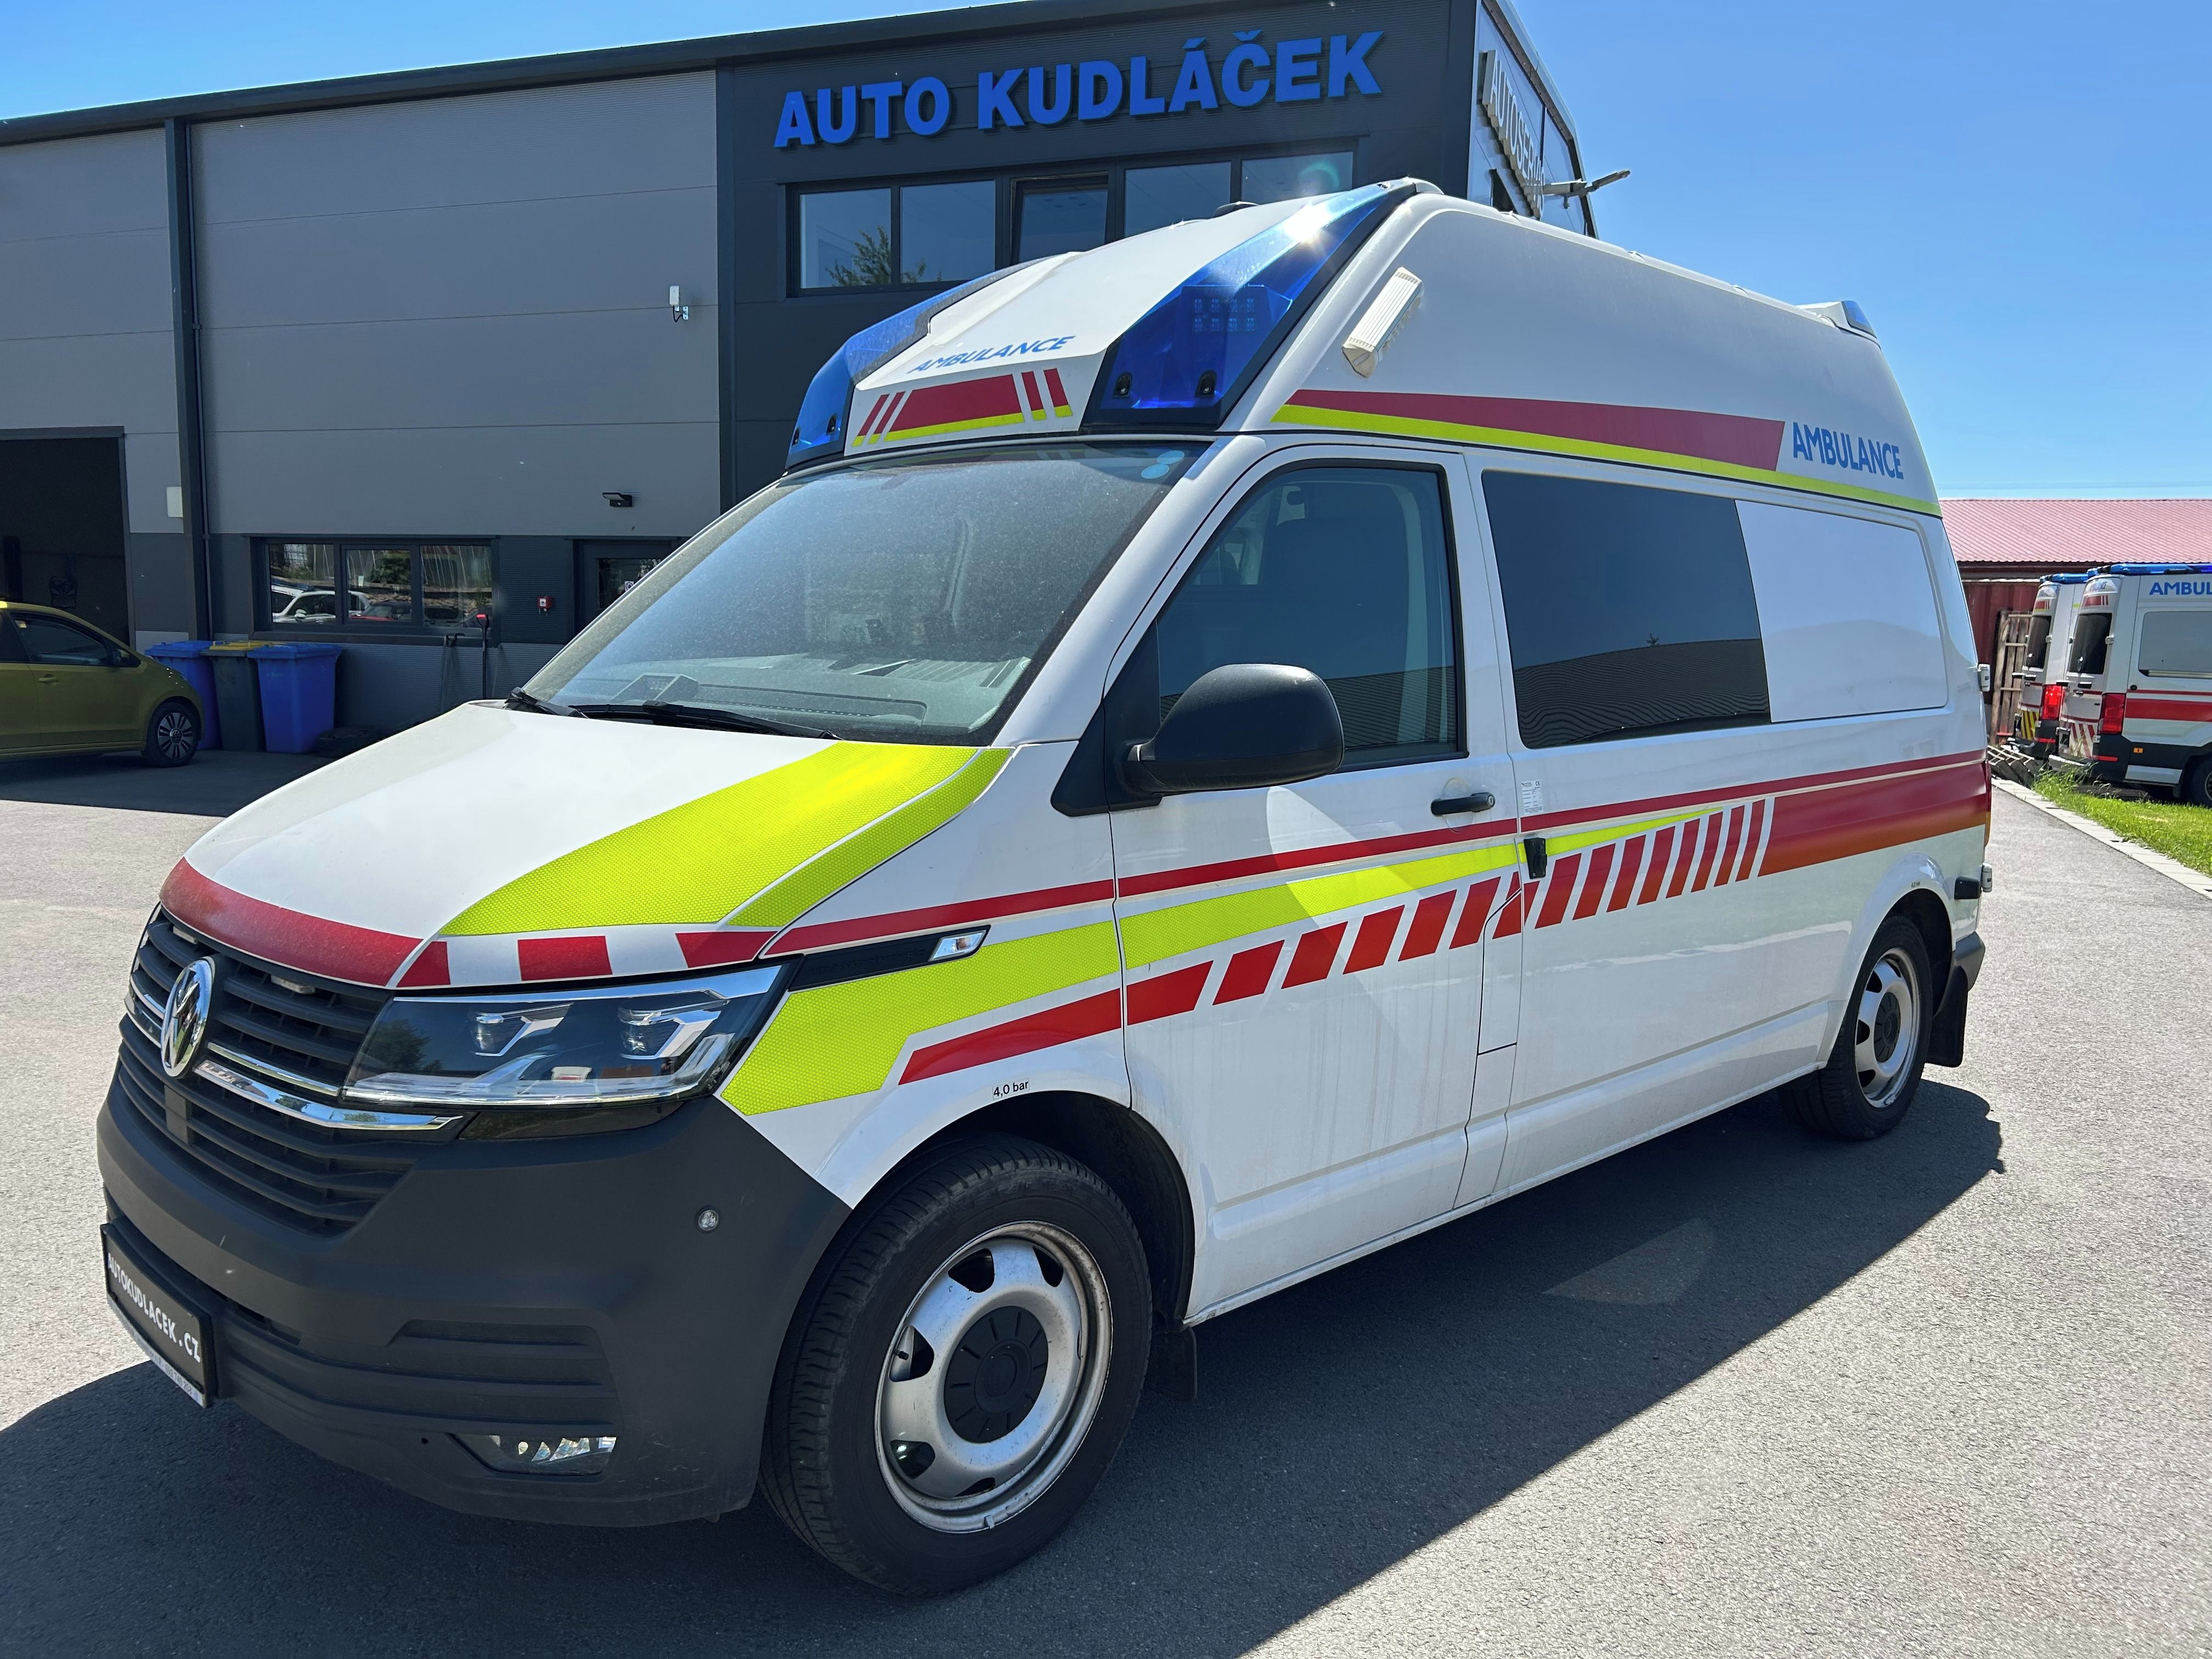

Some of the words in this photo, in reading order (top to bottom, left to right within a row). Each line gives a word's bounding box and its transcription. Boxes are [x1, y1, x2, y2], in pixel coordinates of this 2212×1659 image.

[774, 76, 952, 149] AUTO
[978, 29, 1384, 131] KUDLÁČEK
[906, 335, 1076, 374] AMBULANCE
[1792, 421, 1904, 480] AMBULANCE
[994, 1084, 1010, 1097] 4,0
[1013, 1080, 1029, 1092] bar
